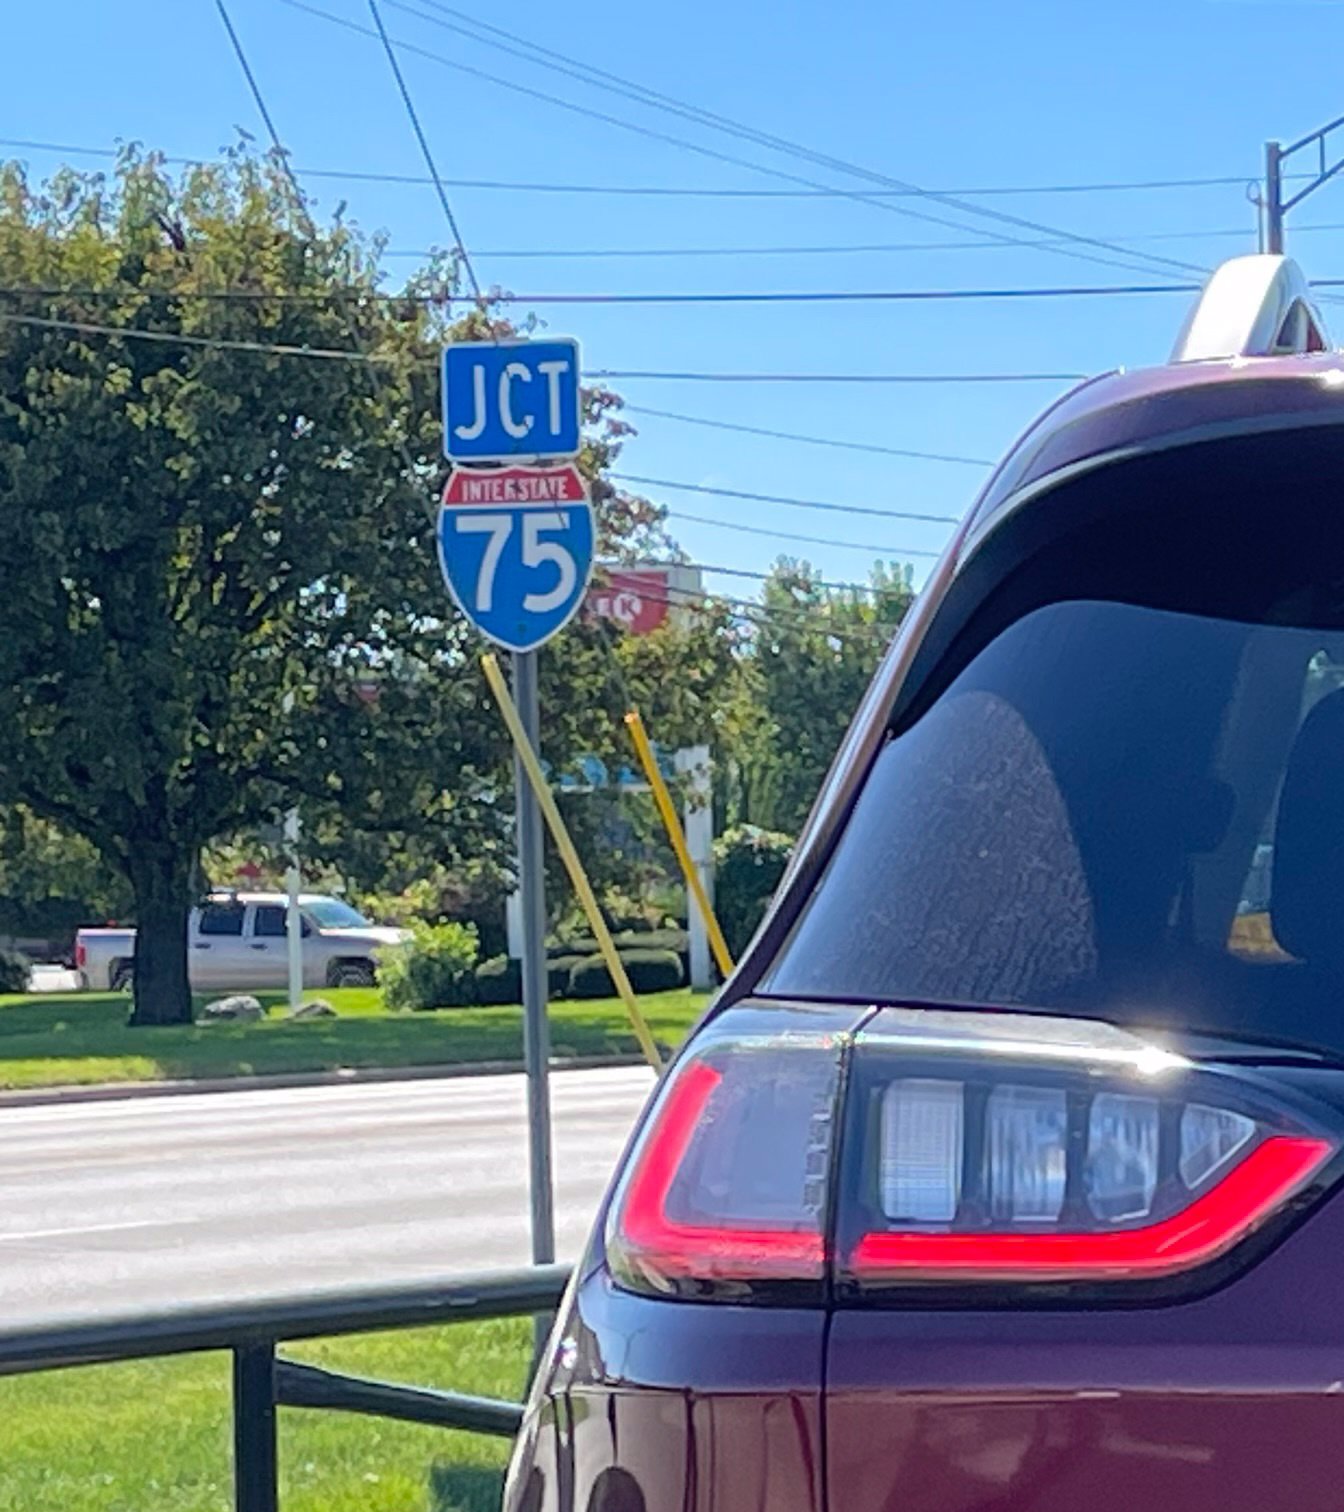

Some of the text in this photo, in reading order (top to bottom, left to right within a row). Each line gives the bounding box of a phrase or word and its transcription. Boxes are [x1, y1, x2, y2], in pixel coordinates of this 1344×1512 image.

[454, 361, 570, 441] JCT
[462, 476, 568, 502] INTERSTATE
[455, 512, 577, 612] 75
